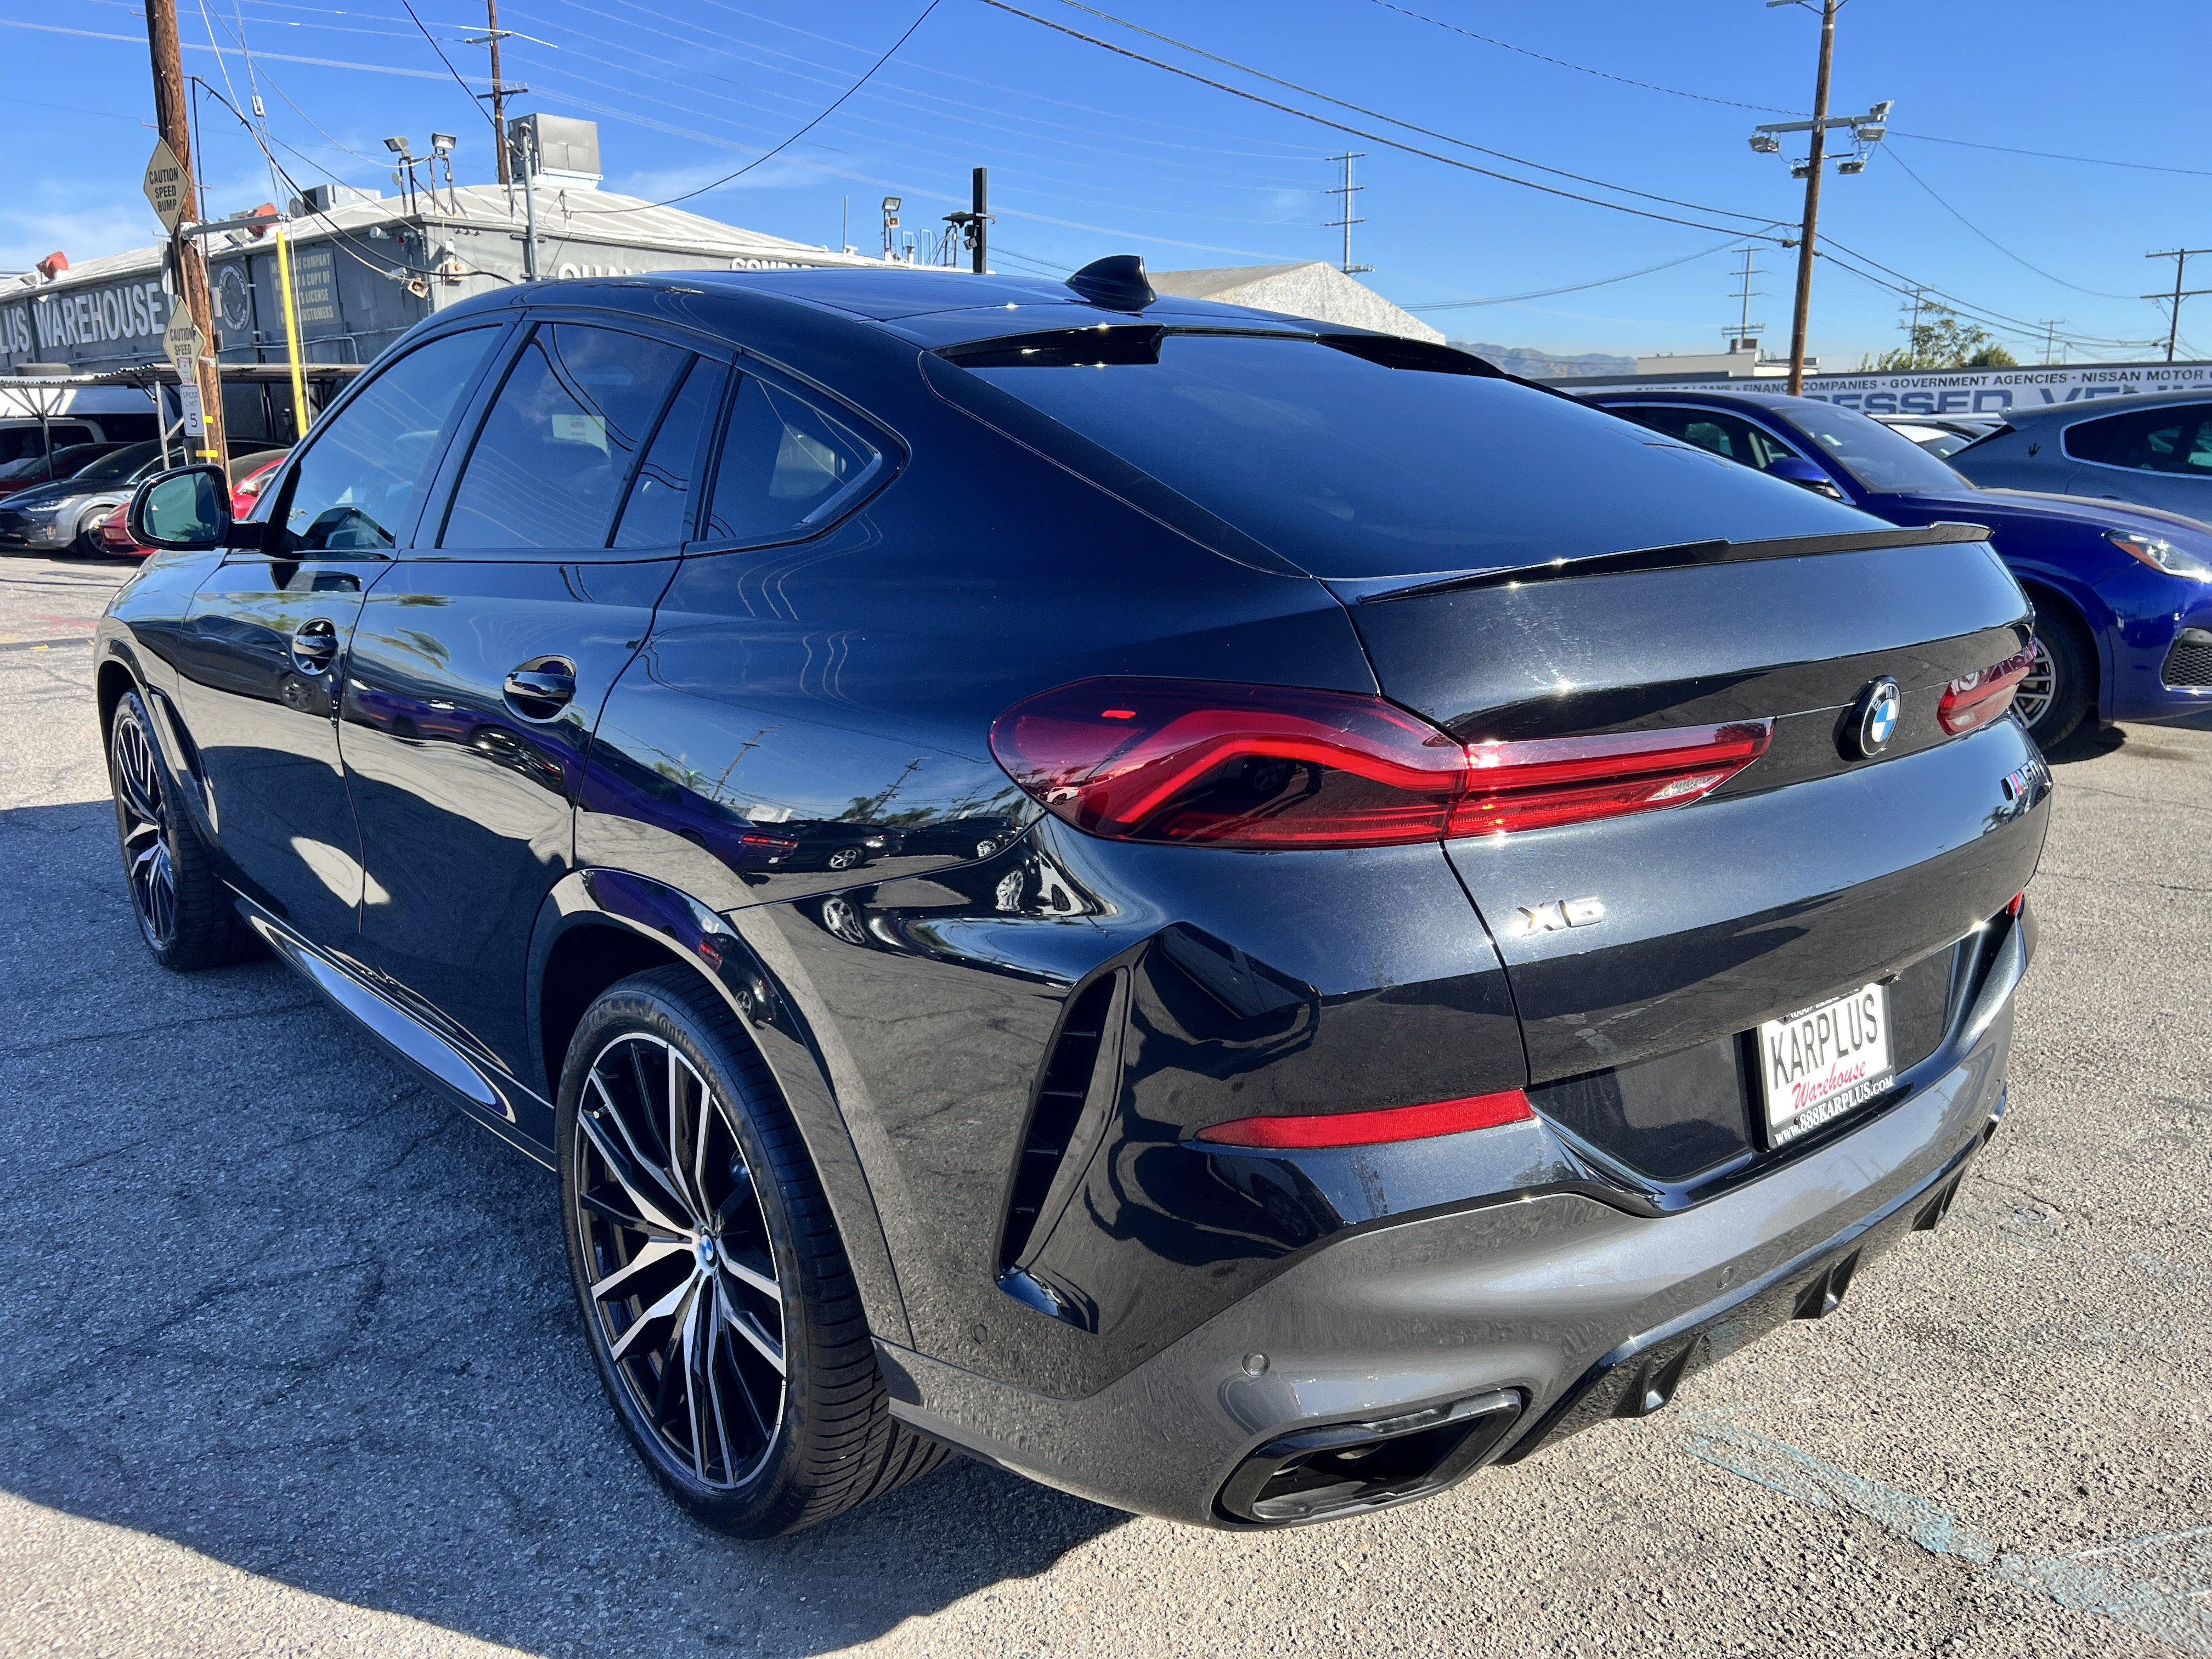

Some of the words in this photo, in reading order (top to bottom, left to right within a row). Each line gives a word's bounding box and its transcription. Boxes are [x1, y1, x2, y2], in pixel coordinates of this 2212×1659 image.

[149, 167, 179, 185] CAUTION
[155, 185, 177, 199] SPEED
[157, 199, 177, 212] BUMP
[303, 252, 330, 269] COMPANY
[307, 272, 321, 286] COPY
[323, 270, 330, 284] OF
[306, 289, 329, 303] LICENSE
[33, 283, 165, 348] WAREHOUSE
[170, 326, 194, 341] CAUTION
[174, 344, 191, 356] SPEED
[1802, 380, 1877, 391] COMPANIES
[1891, 376, 1989, 388] GOVERNMENT
[1994, 373, 2068, 384] AGENCIES
[2081, 371, 2141, 382] NISSAN
[2146, 369, 2204, 380] MOTOR
[190, 413, 198, 428] 5
[1770, 993, 1877, 1090] KARPLUS
[1792, 1060, 1865, 1110] Warehouse
